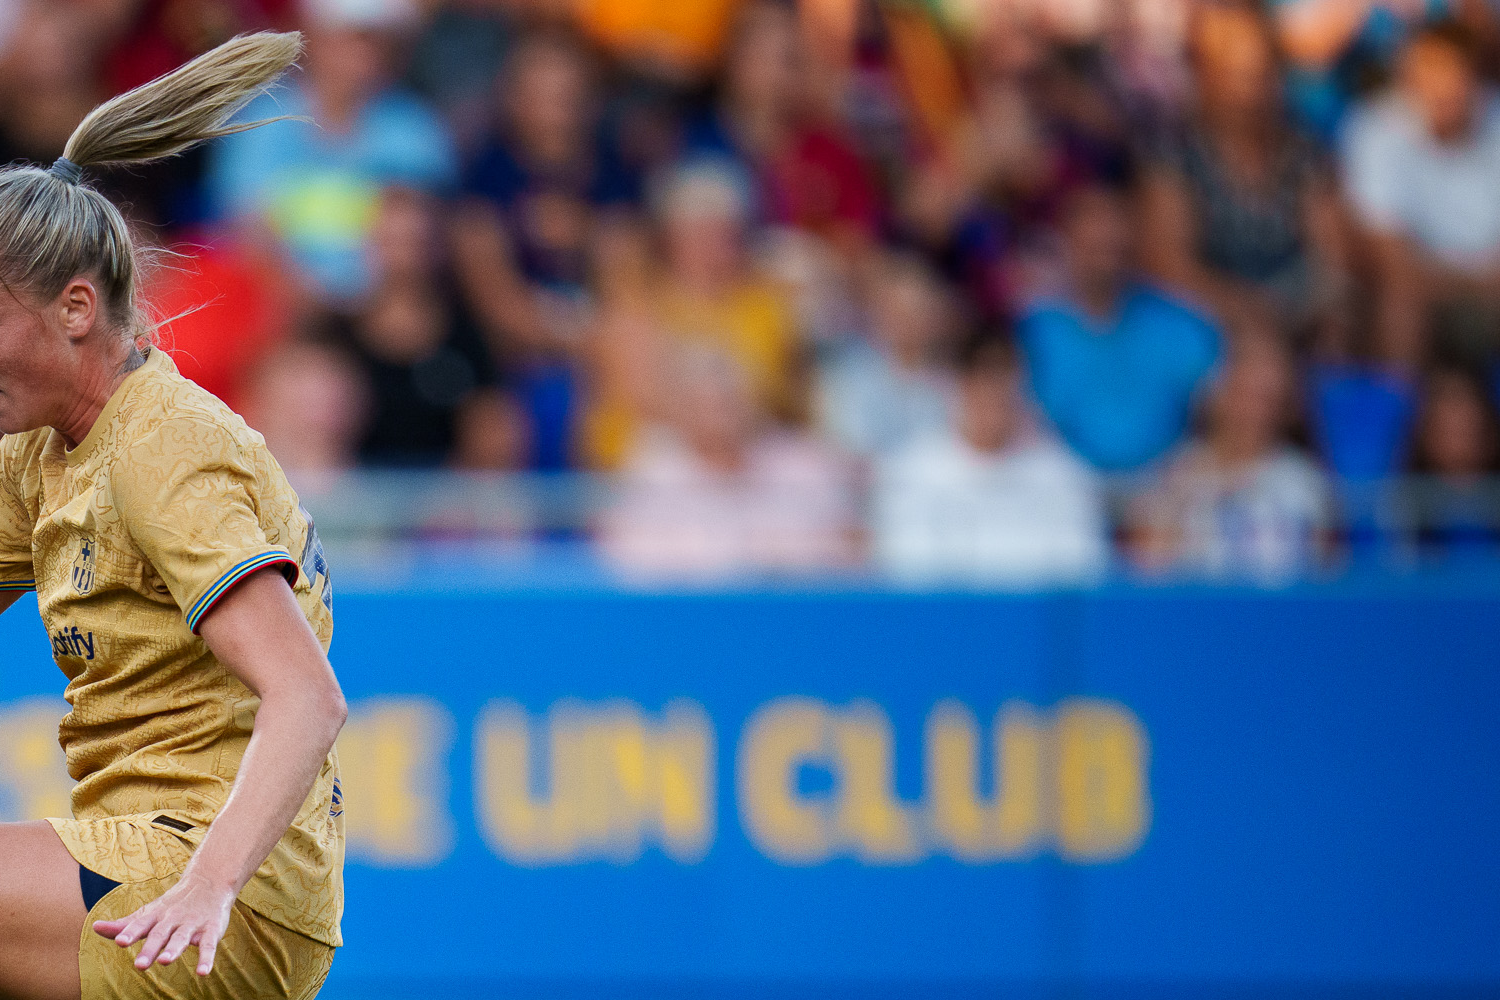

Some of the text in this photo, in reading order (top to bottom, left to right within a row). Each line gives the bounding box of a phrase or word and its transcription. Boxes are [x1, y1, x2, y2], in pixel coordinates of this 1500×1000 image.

[52, 626, 94, 660] otify
[476, 698, 712, 864] UN
[738, 696, 1152, 864] CLUB
